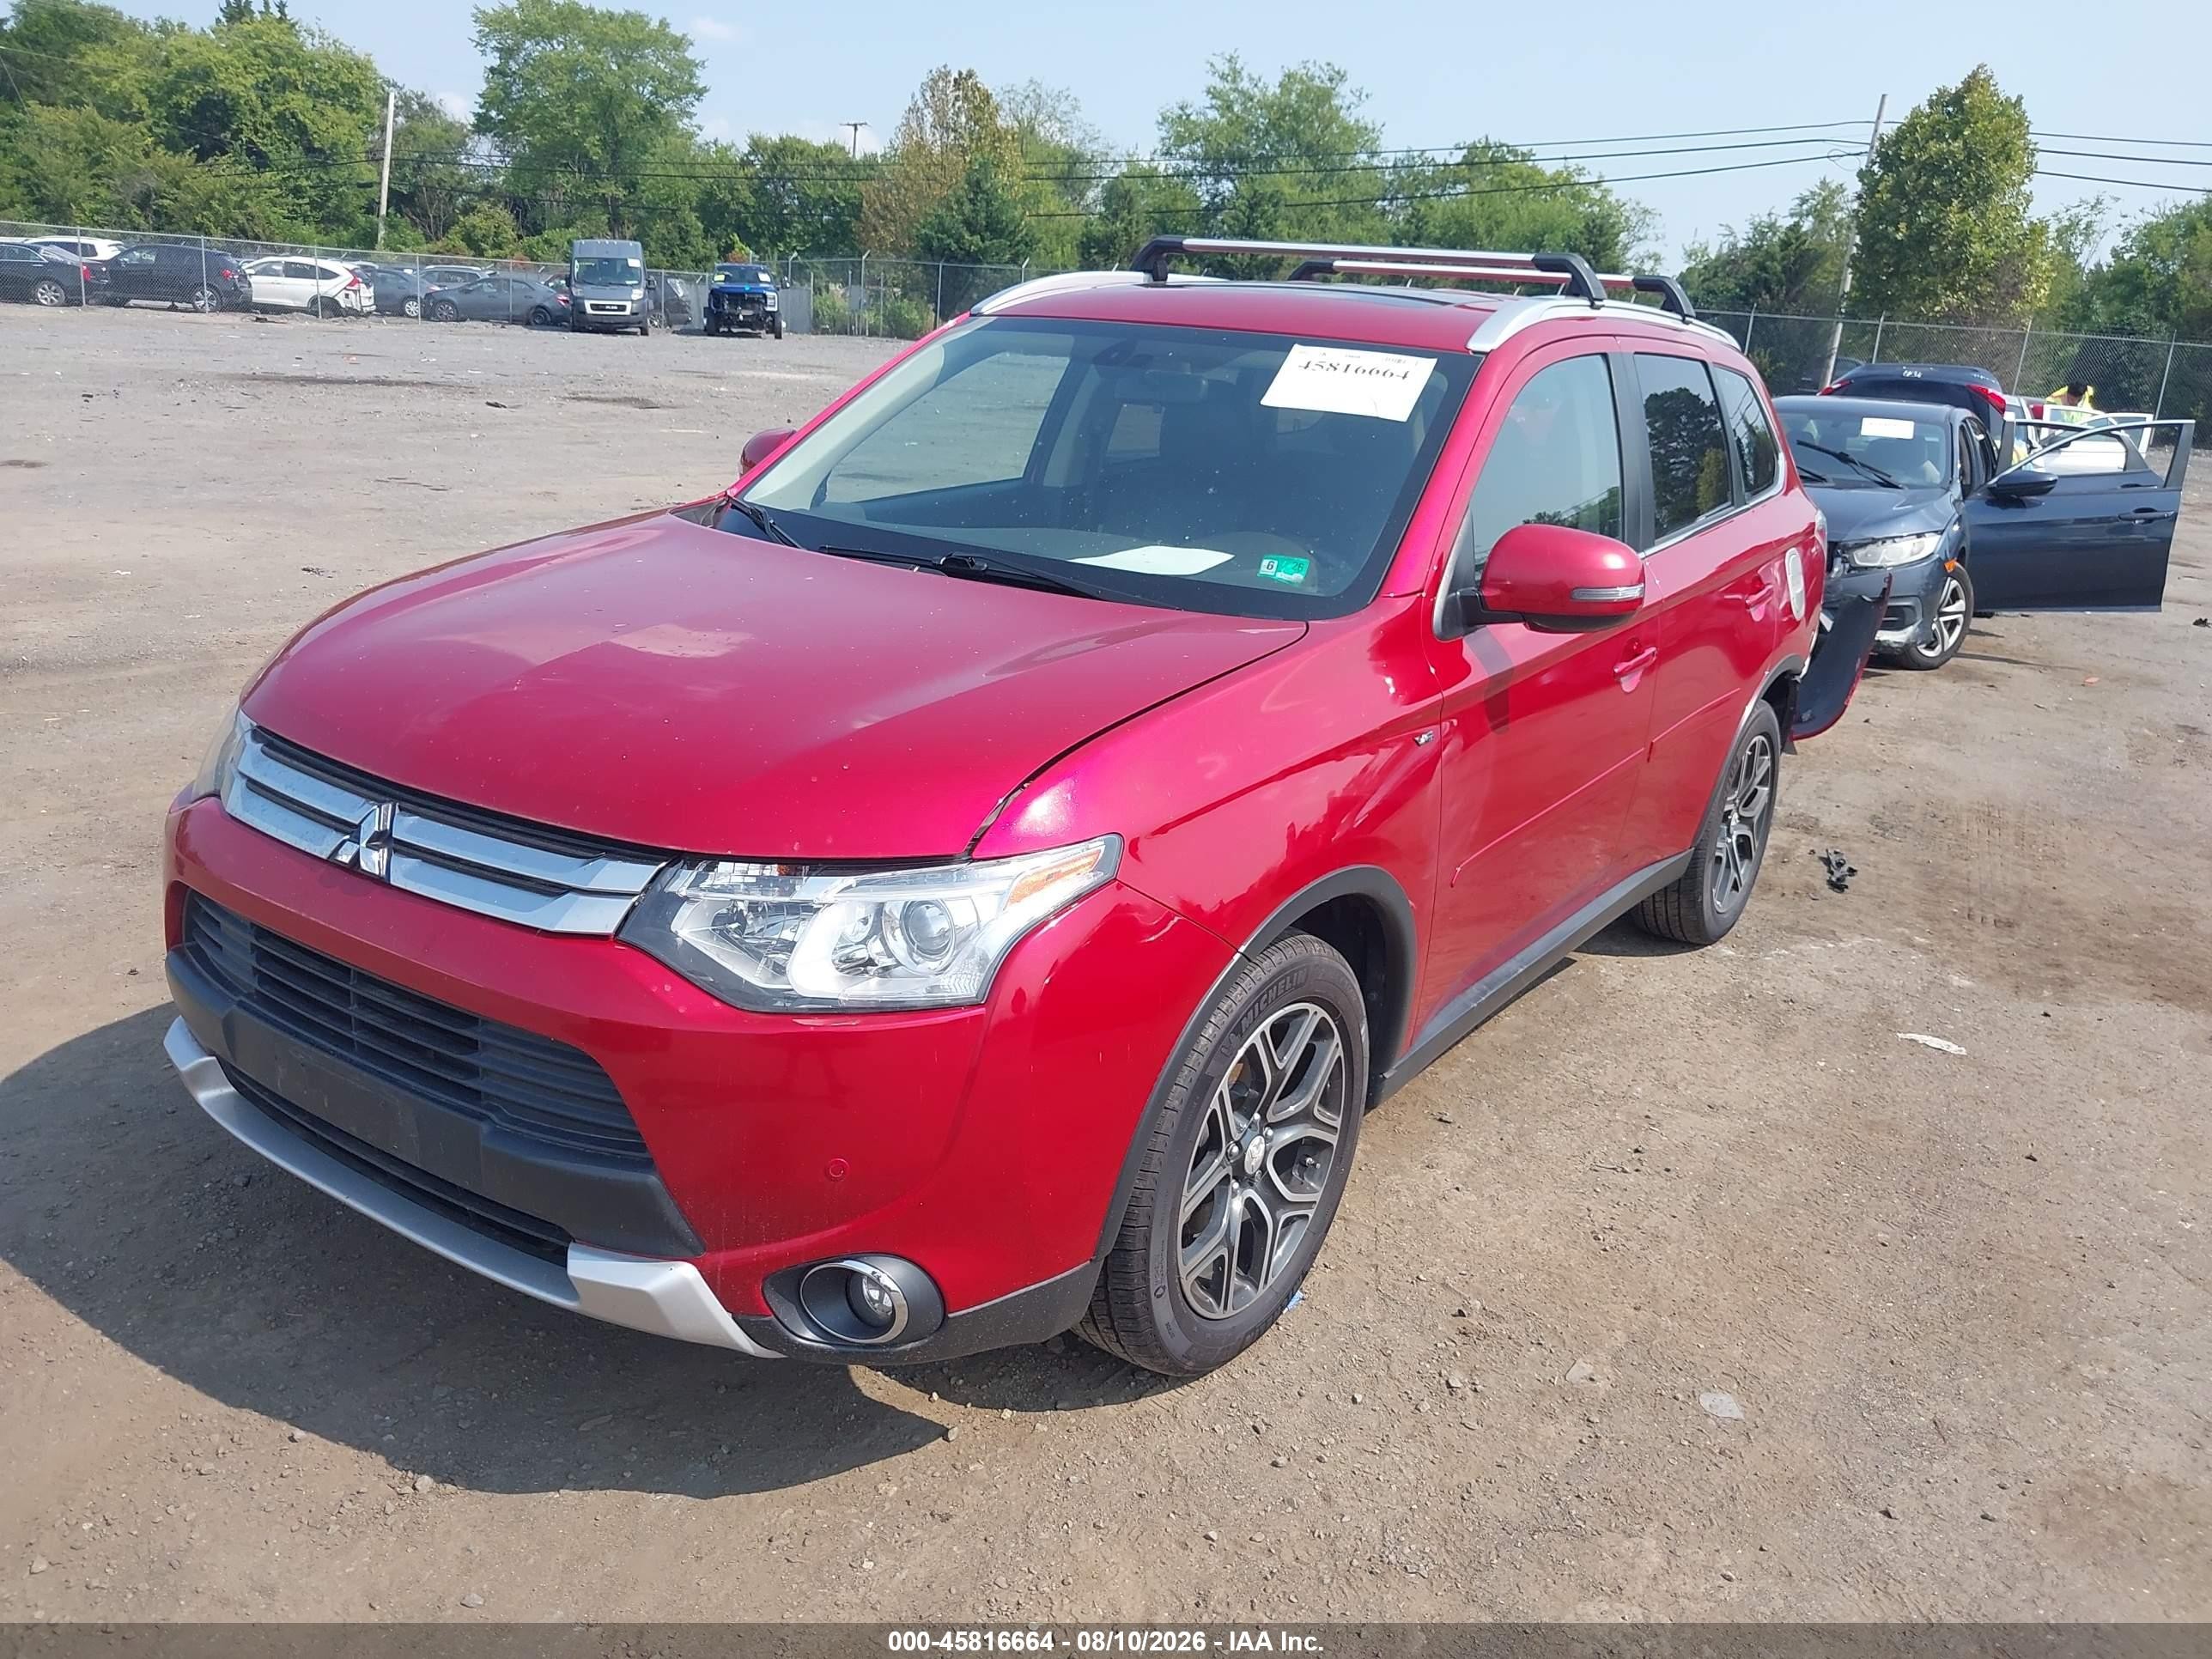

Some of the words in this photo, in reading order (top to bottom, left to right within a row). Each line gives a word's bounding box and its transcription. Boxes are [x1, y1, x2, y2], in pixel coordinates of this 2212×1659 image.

[1298, 360, 1409, 380] 45816664
[1267, 561, 1275, 570] 6
[1237, 967, 1309, 1036] MICHELIN
